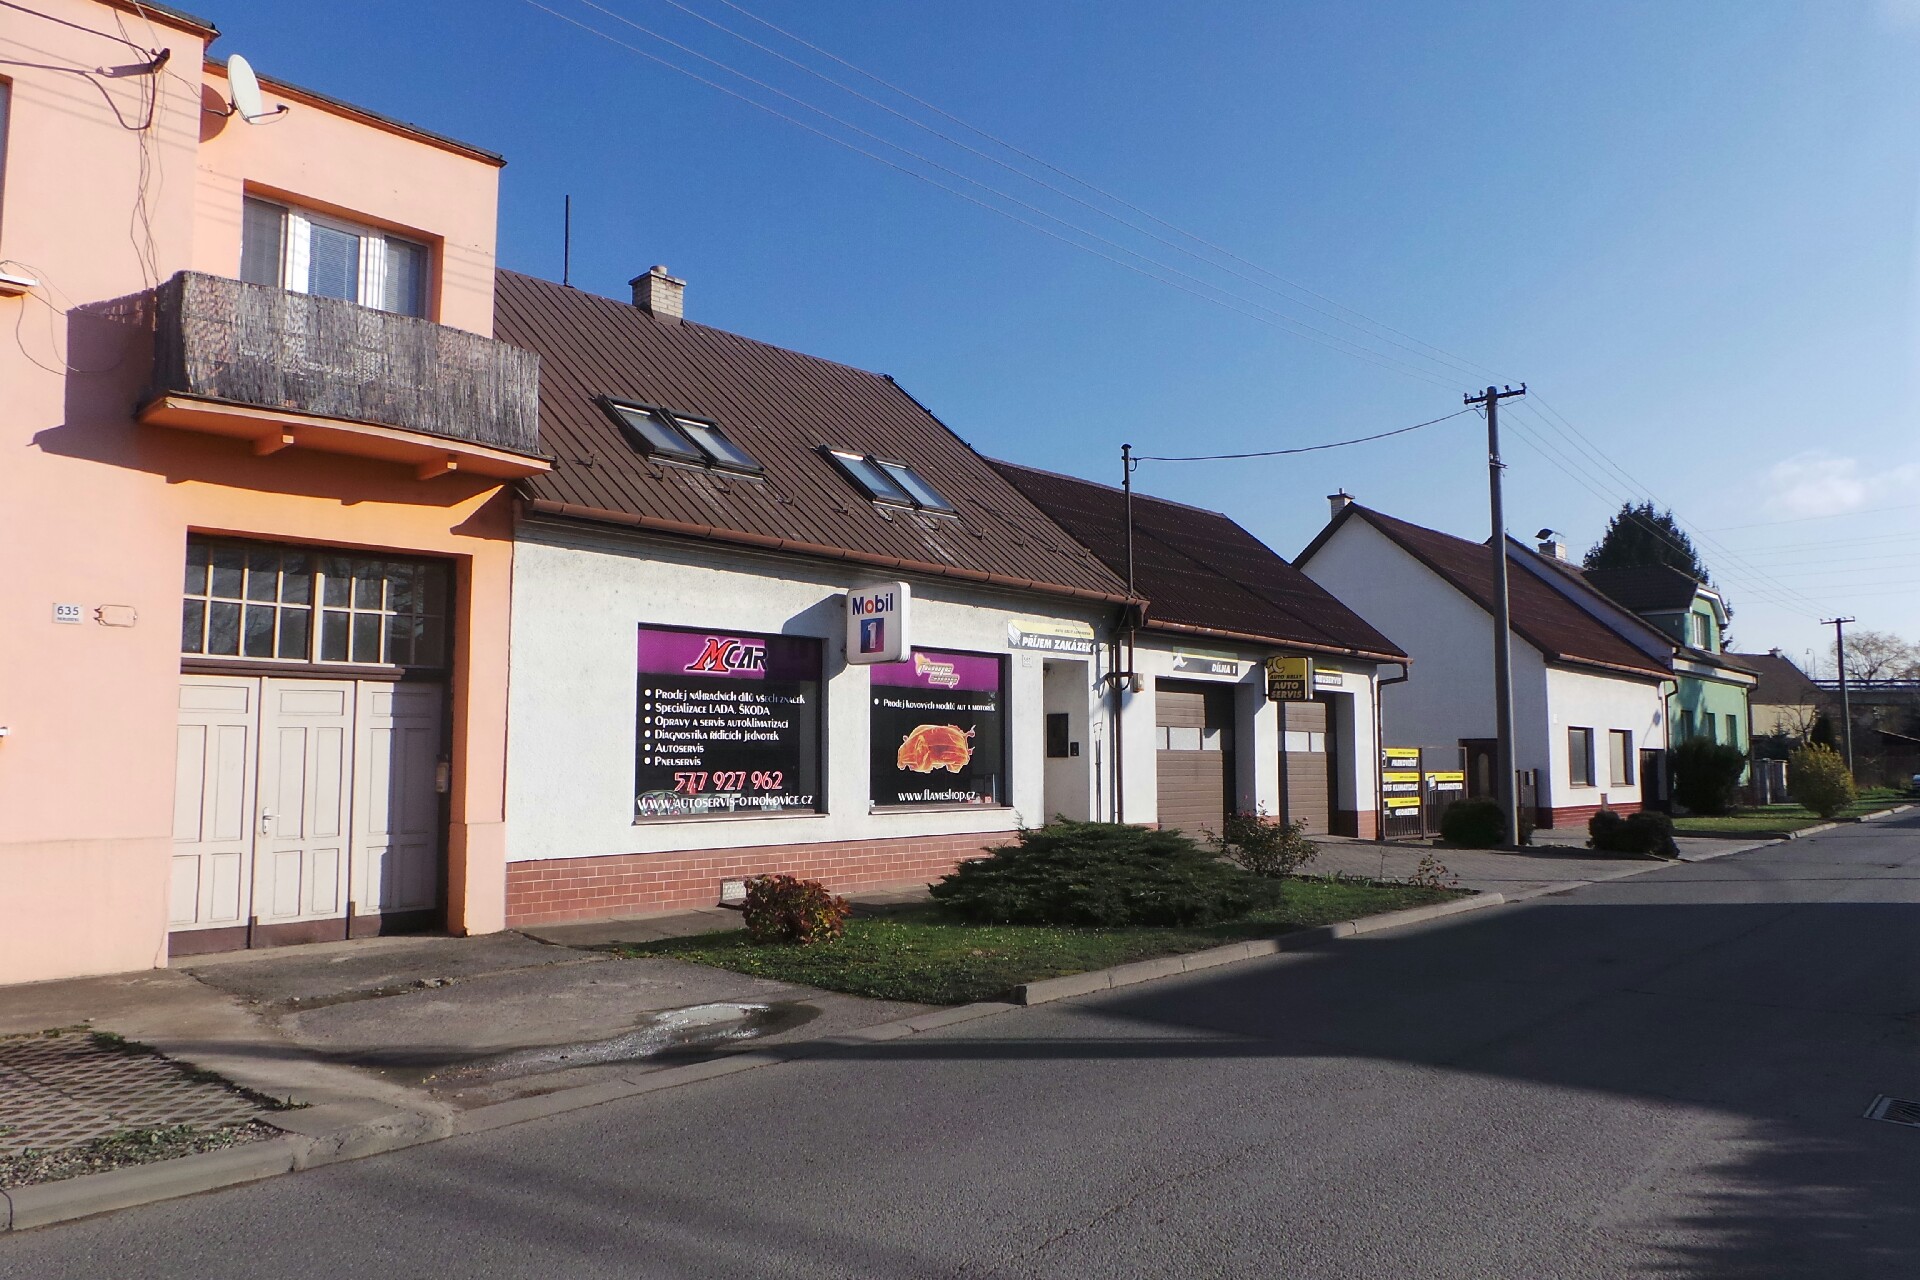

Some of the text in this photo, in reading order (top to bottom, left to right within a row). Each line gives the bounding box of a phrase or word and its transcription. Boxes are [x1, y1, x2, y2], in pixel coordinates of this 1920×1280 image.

[852, 592, 894, 616] Mobil
[57, 606, 79, 616] 635
[867, 622, 877, 649] 1
[1021, 634, 1093, 653] PŘÍJEM ZAKÁZEK
[1211, 662, 1237, 674] DÍLNA 1
[1273, 681, 1299, 690] AUTO
[655, 689, 687, 702] Prodej
[1271, 690, 1302, 699] SERVIS
[655, 702, 707, 714] Specializace
[738, 703, 771, 716] ŠKODA
[654, 715, 691, 729] Opravy
[654, 742, 705, 753] Autoservis
[654, 755, 702, 766] Pneuservis
[674, 770, 784, 792] 577 927 962
